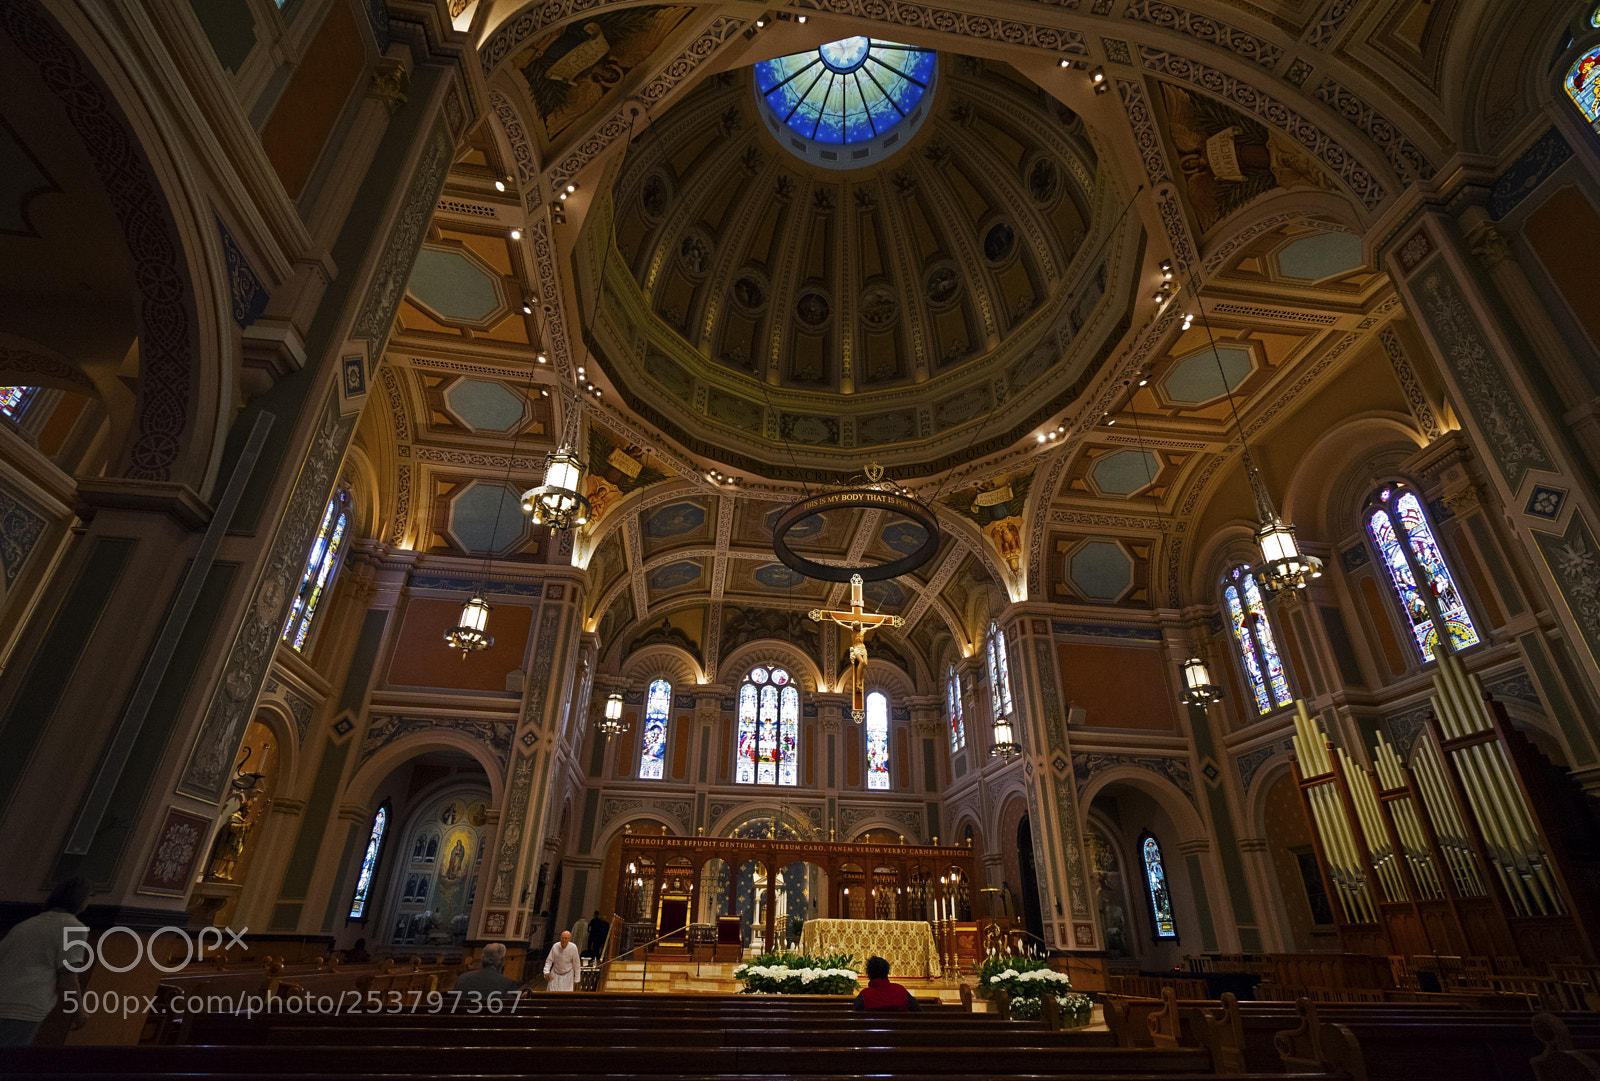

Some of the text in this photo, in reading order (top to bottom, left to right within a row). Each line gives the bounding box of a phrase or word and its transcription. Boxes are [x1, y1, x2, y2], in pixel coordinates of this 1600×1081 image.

[804, 500, 818, 510] THIS
[827, 494, 840, 503] MY
[841, 493, 864, 501] BODY
[866, 493, 886, 502] THAT
[624, 837, 664, 845] GENEROSI
[684, 840, 717, 848] EFFUDIT
